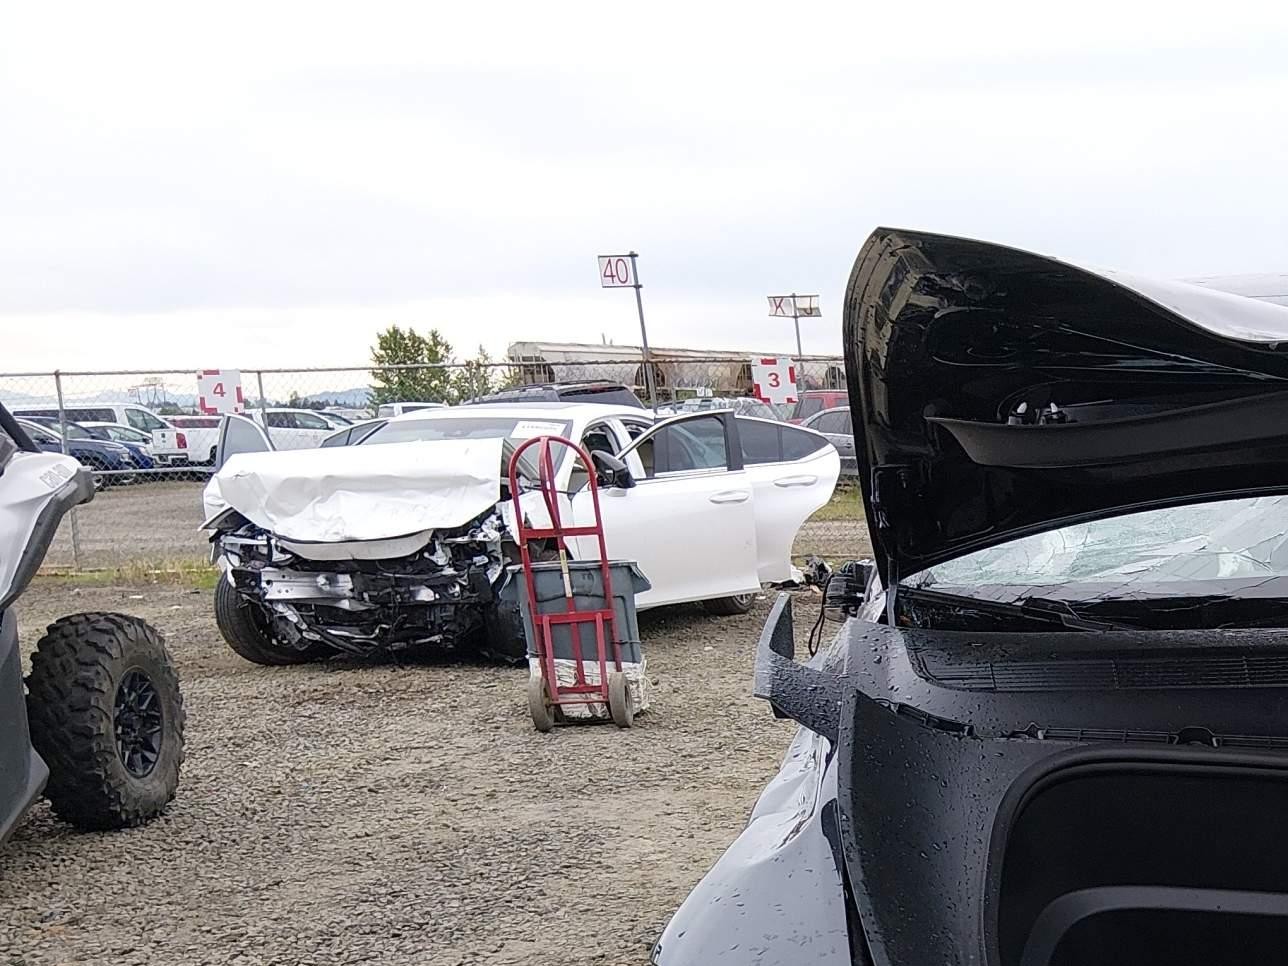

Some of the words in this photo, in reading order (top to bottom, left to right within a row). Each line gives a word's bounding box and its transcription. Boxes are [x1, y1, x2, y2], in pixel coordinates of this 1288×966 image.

[603, 258, 628, 284] 40
[773, 297, 786, 315] K
[768, 372, 780, 388] 3
[213, 382, 226, 397] 4
